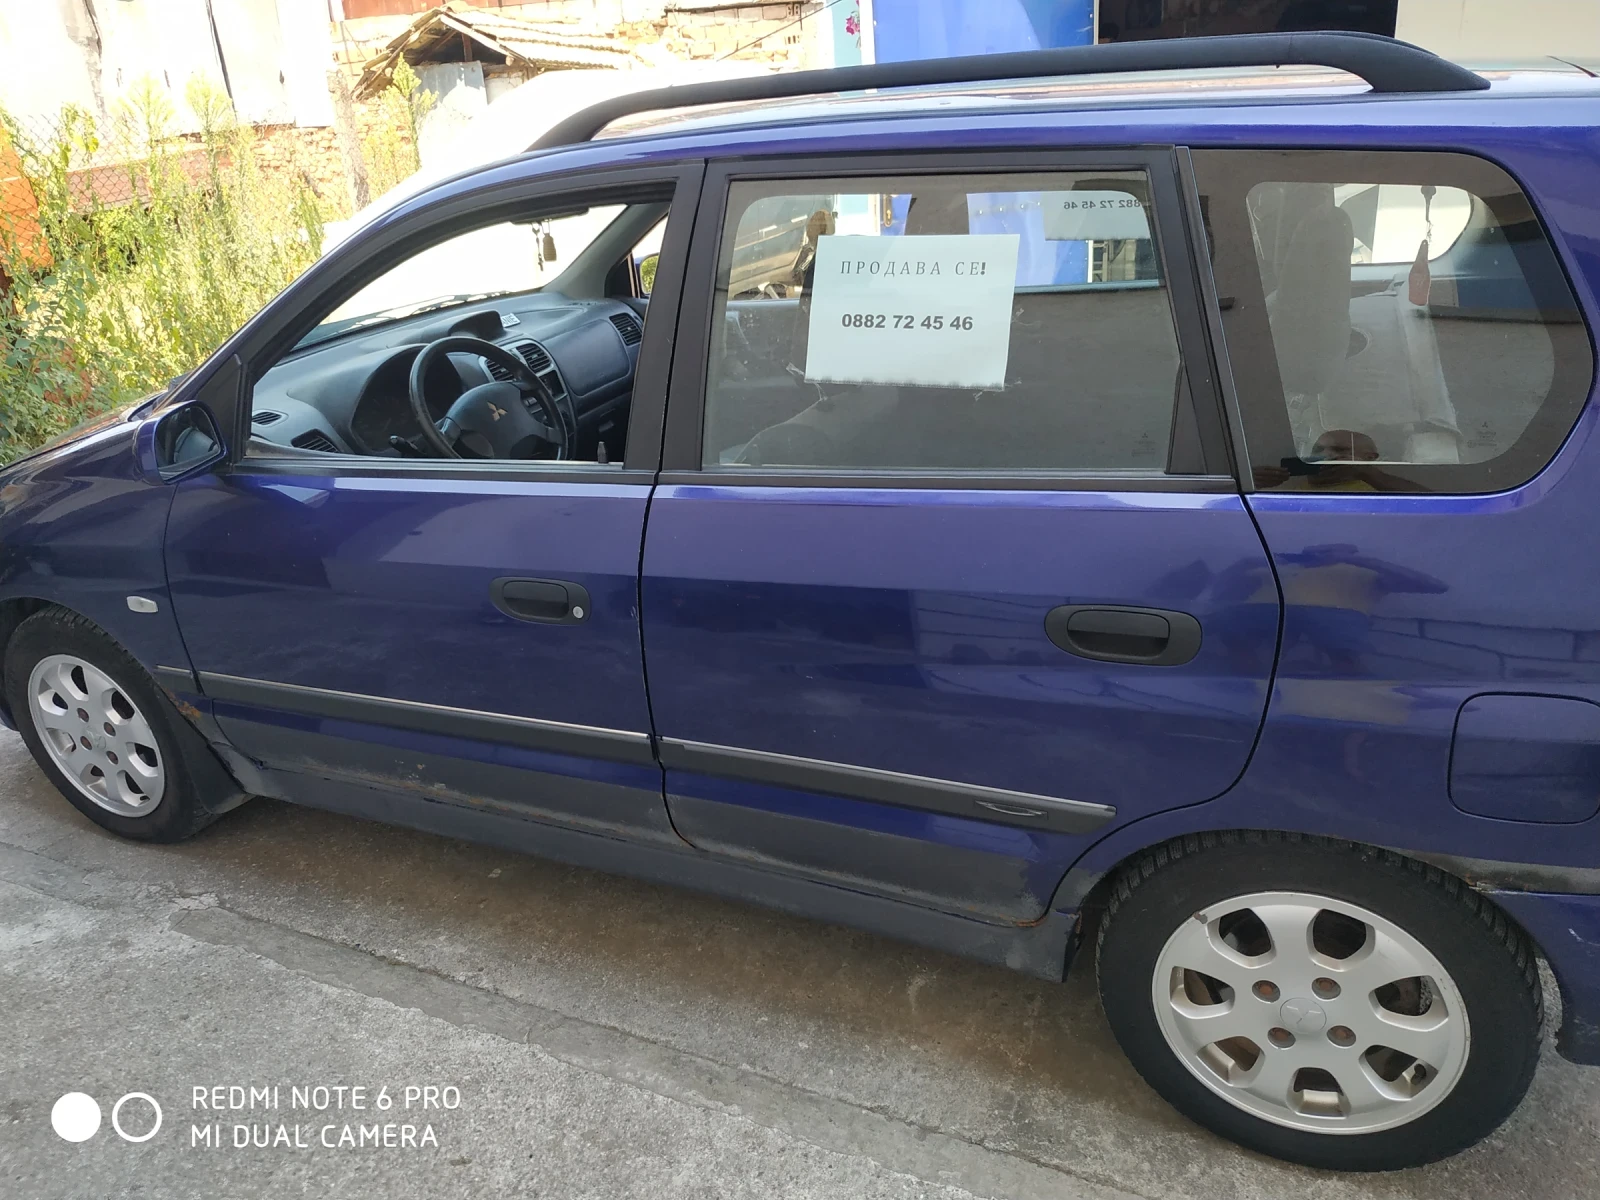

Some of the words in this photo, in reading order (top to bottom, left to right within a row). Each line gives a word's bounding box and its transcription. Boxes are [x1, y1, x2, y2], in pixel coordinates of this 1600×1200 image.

[840, 260, 941, 277] ПРОДАВА
[954, 261, 987, 276] СЕ!
[841, 313, 886, 329] 0882
[892, 314, 915, 329] 72
[920, 315, 944, 330] 45
[949, 316, 973, 331] 46
